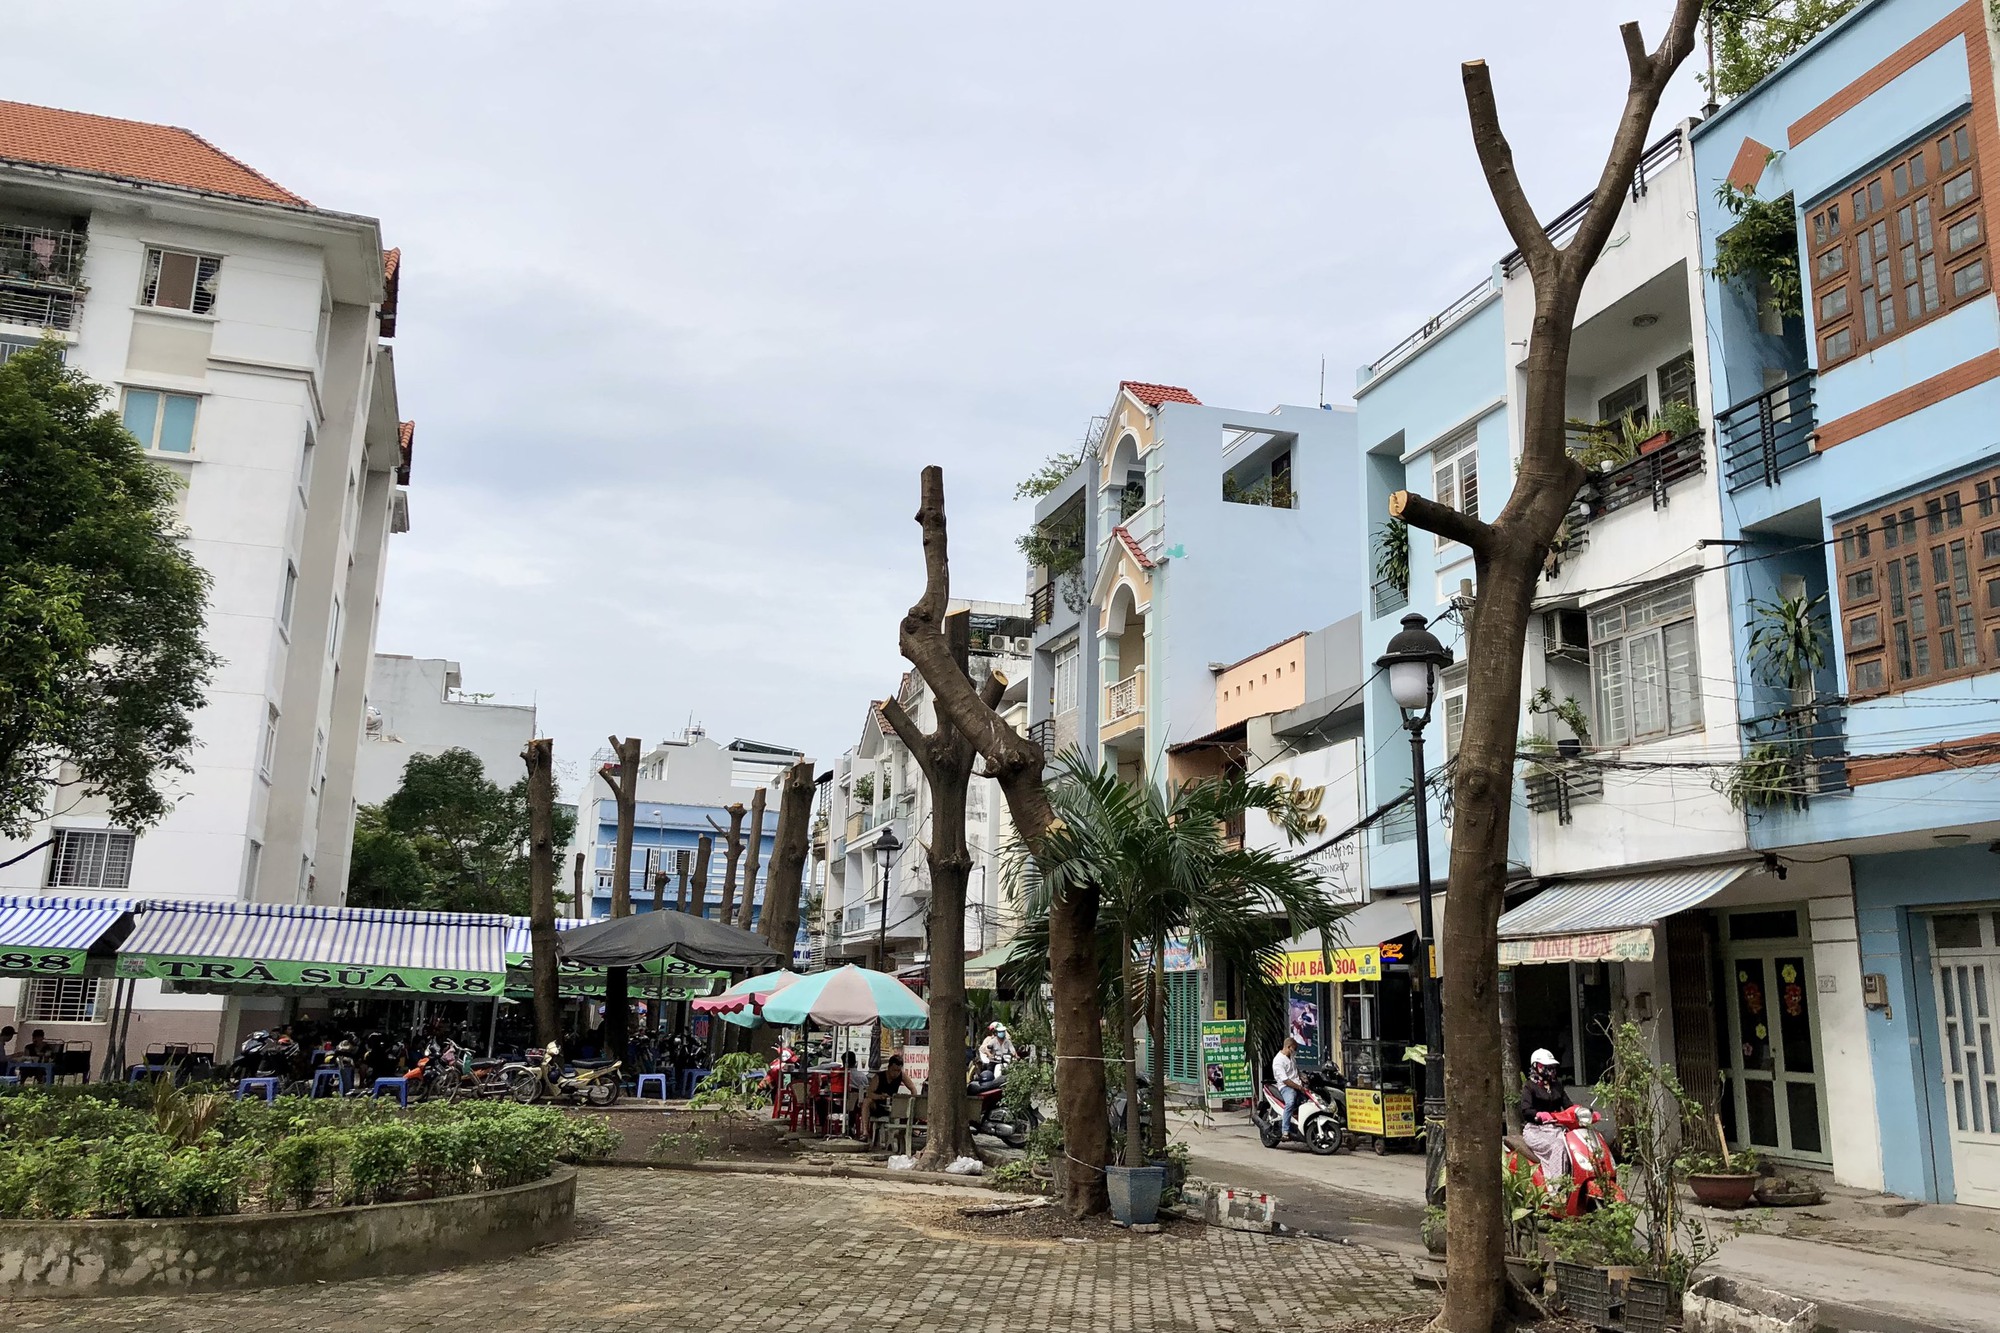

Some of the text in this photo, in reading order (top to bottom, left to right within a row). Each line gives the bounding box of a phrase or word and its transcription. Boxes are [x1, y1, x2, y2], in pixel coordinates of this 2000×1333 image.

[1533, 938, 1573, 958] MINH
[0, 953, 72, 971] 88
[1335, 958, 1357, 975] 30A
[158, 960, 279, 983] TRÀ
[301, 966, 411, 989] SỮA
[429, 975, 493, 993] 88
